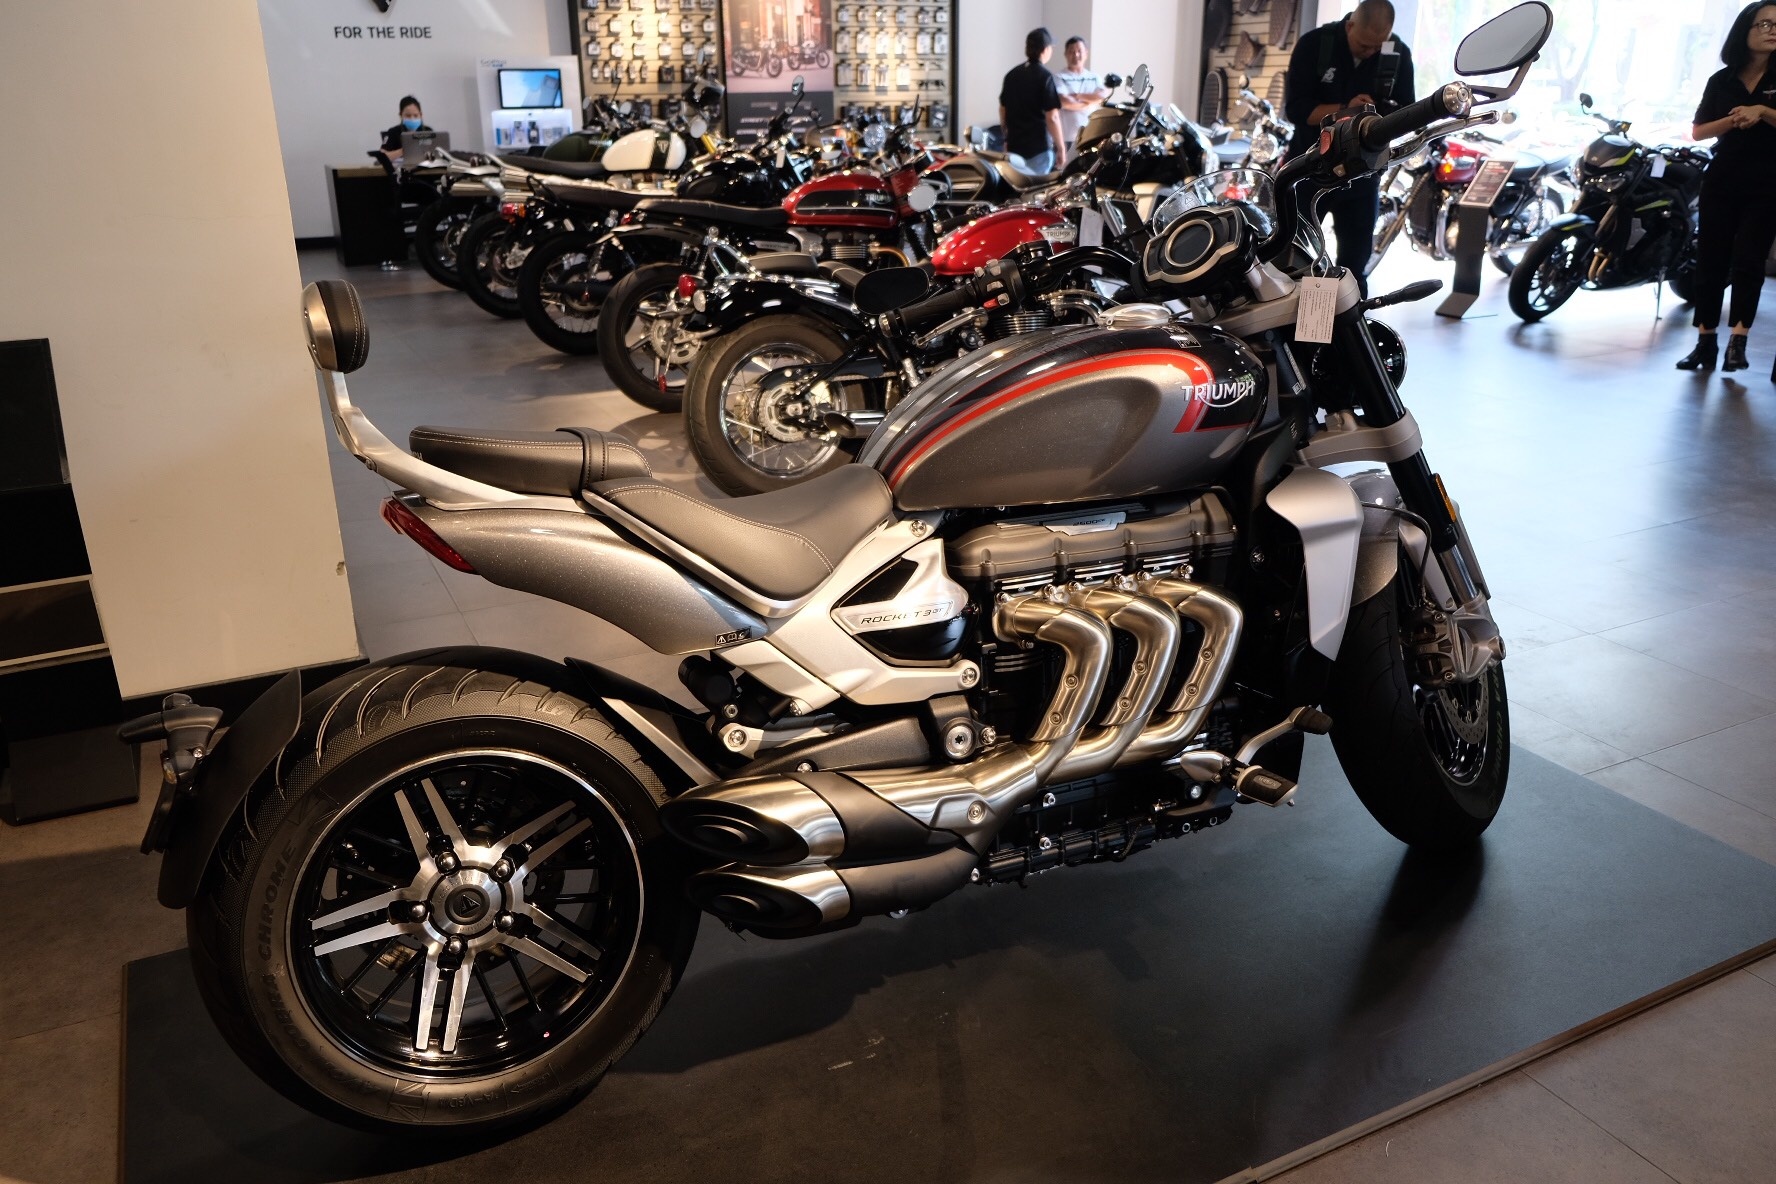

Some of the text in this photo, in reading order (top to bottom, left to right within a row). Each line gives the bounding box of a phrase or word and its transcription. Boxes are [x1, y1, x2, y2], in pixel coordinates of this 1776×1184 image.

[333, 26, 433, 39] FOR THE RIDE
[1182, 380, 1255, 408] TRIUMPH
[861, 611, 922, 624] ROCKT
[258, 841, 297, 961] CHROME
